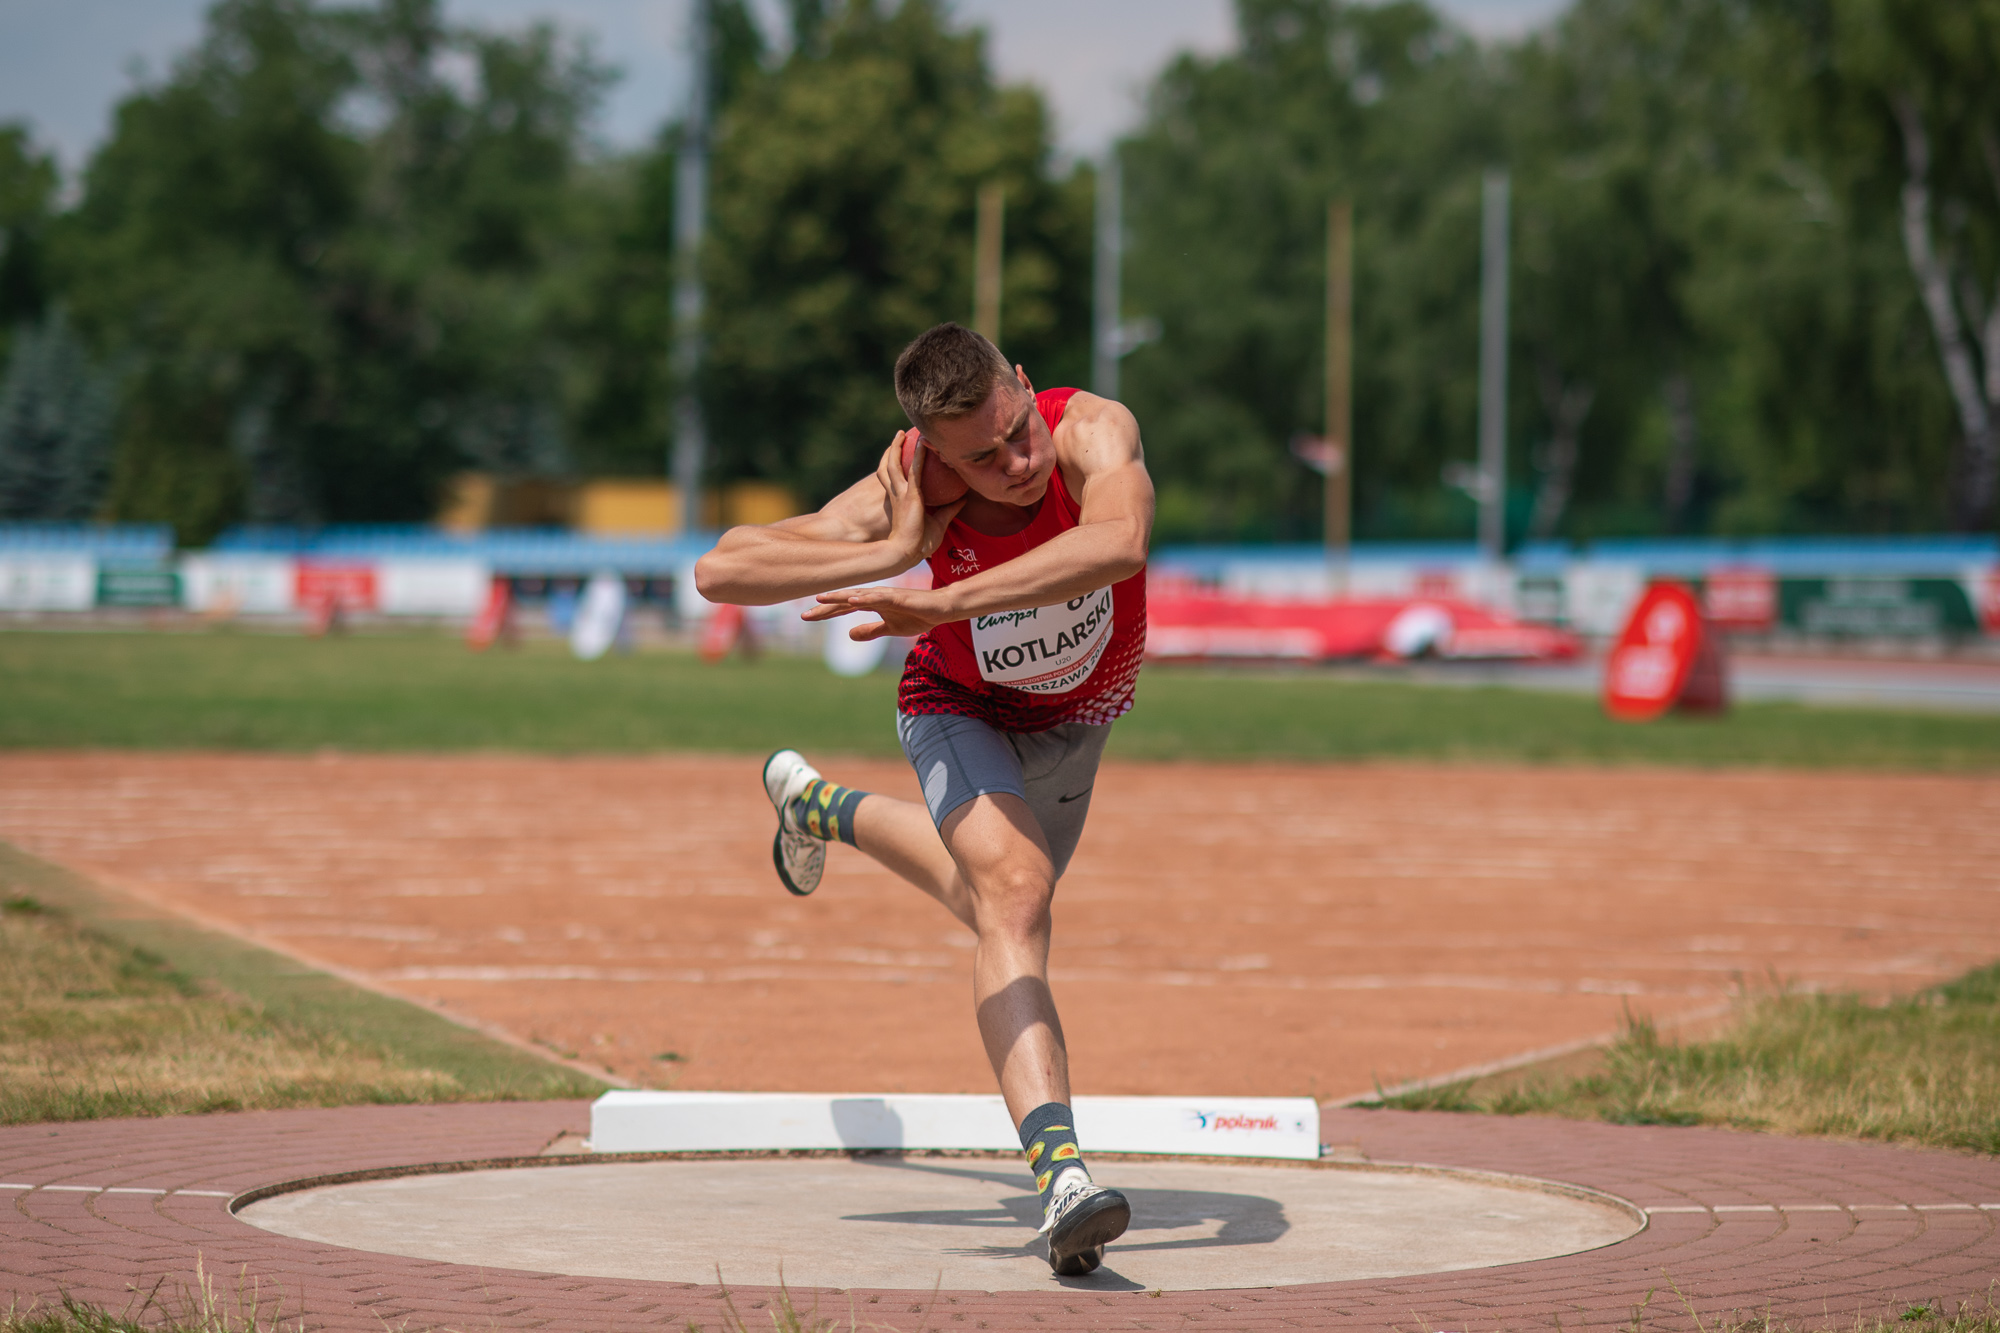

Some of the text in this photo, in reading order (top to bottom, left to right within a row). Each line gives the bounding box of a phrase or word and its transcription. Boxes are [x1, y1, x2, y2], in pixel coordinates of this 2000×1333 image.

[982, 590, 1110, 673] KOTLARSKI
[1055, 656, 1071, 666] U20
[1053, 666, 1073, 677] POLSKI
[1214, 1115, 1278, 1132] polanik
